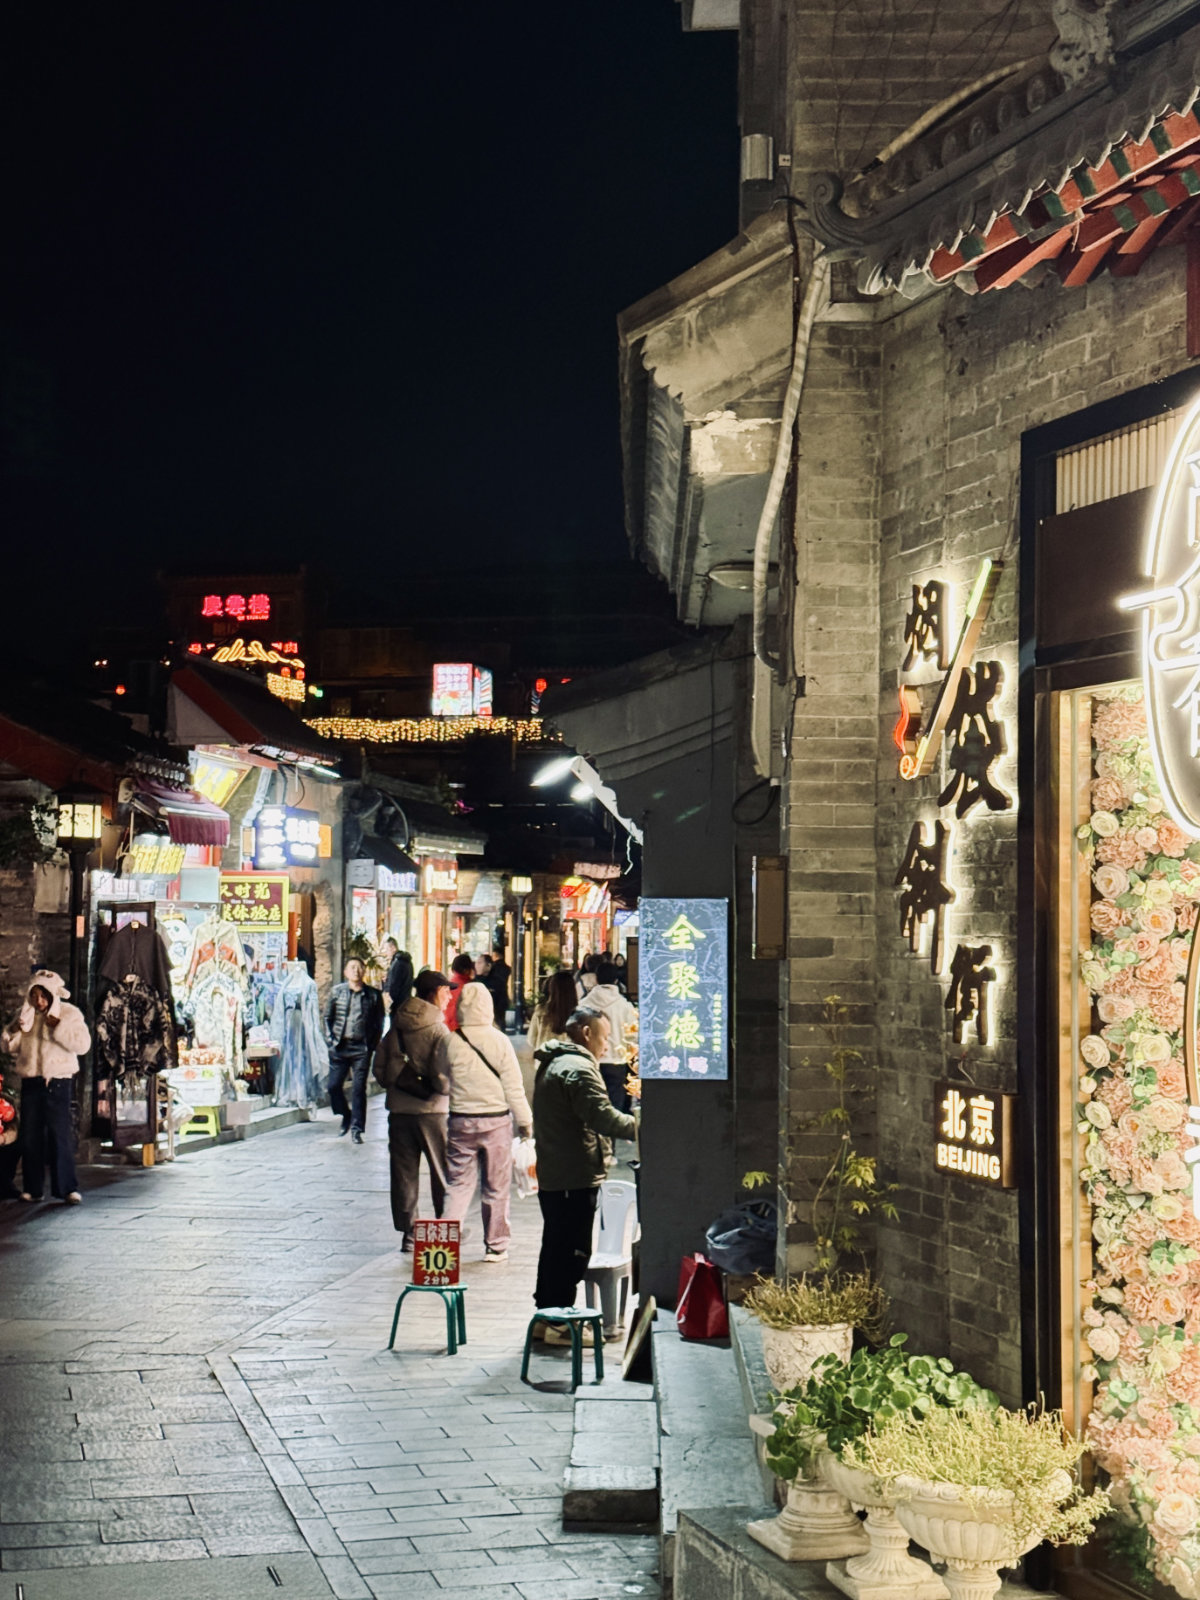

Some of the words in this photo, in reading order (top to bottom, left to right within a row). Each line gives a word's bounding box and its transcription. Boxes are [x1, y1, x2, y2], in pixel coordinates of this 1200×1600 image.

[661, 914, 706, 1049] 全聚德
[942, 1089, 995, 1145] 北京
[937, 1143, 1001, 1180] BEIJING
